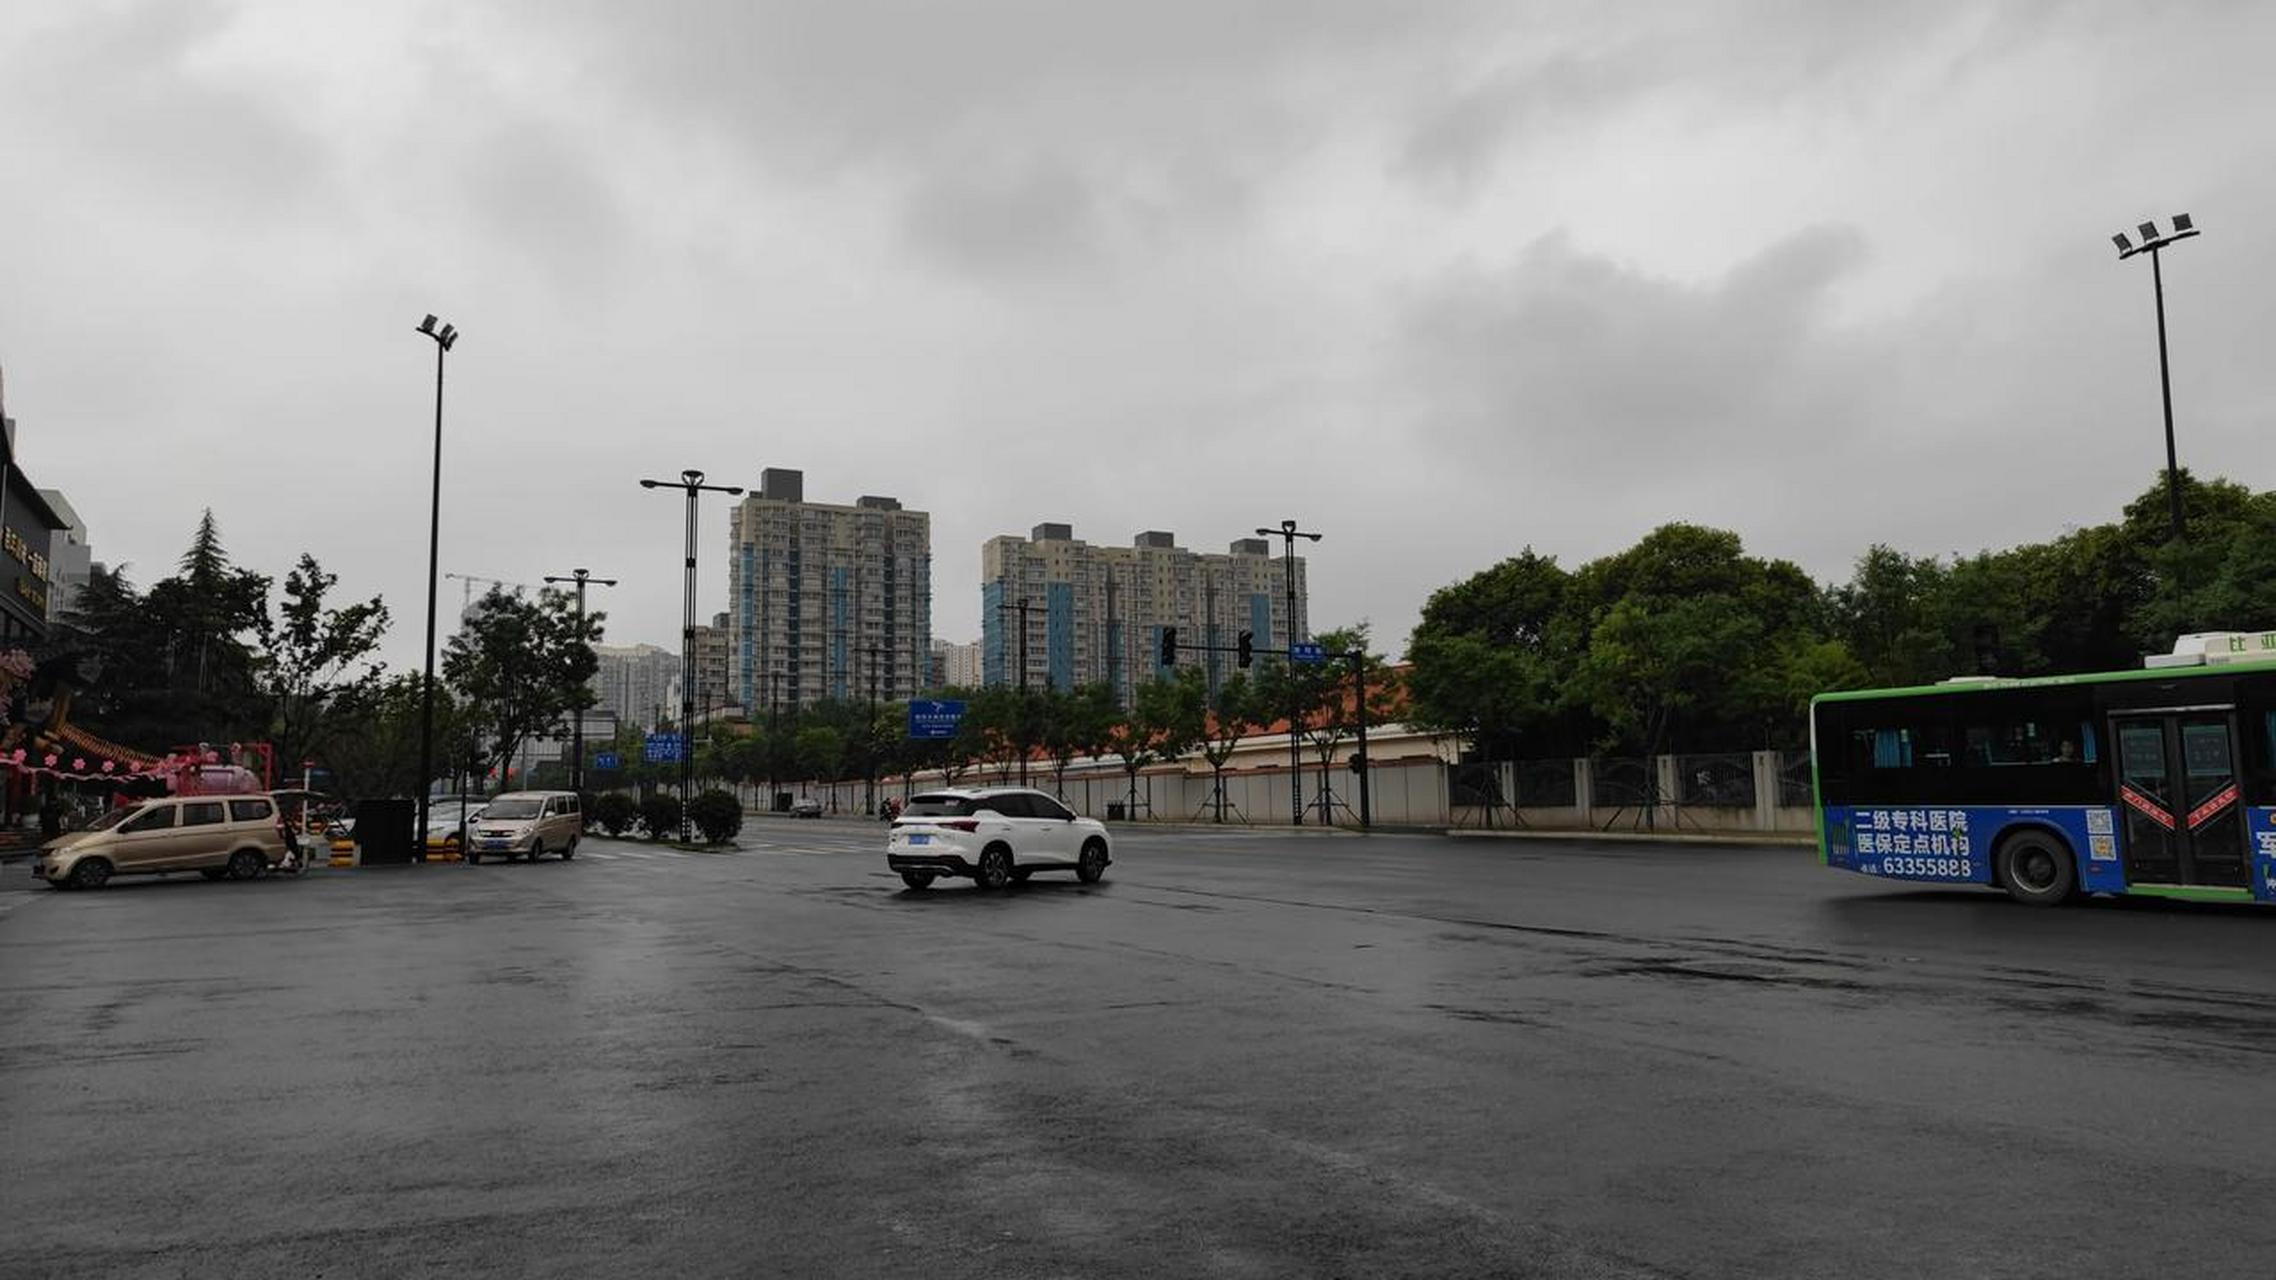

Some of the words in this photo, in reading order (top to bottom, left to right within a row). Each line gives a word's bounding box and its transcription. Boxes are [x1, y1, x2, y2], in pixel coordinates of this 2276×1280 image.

[1855, 810, 1968, 831] 二级专科医院
[1857, 833, 1970, 856] 医保定点机构
[1883, 857, 1972, 877] 63355888
